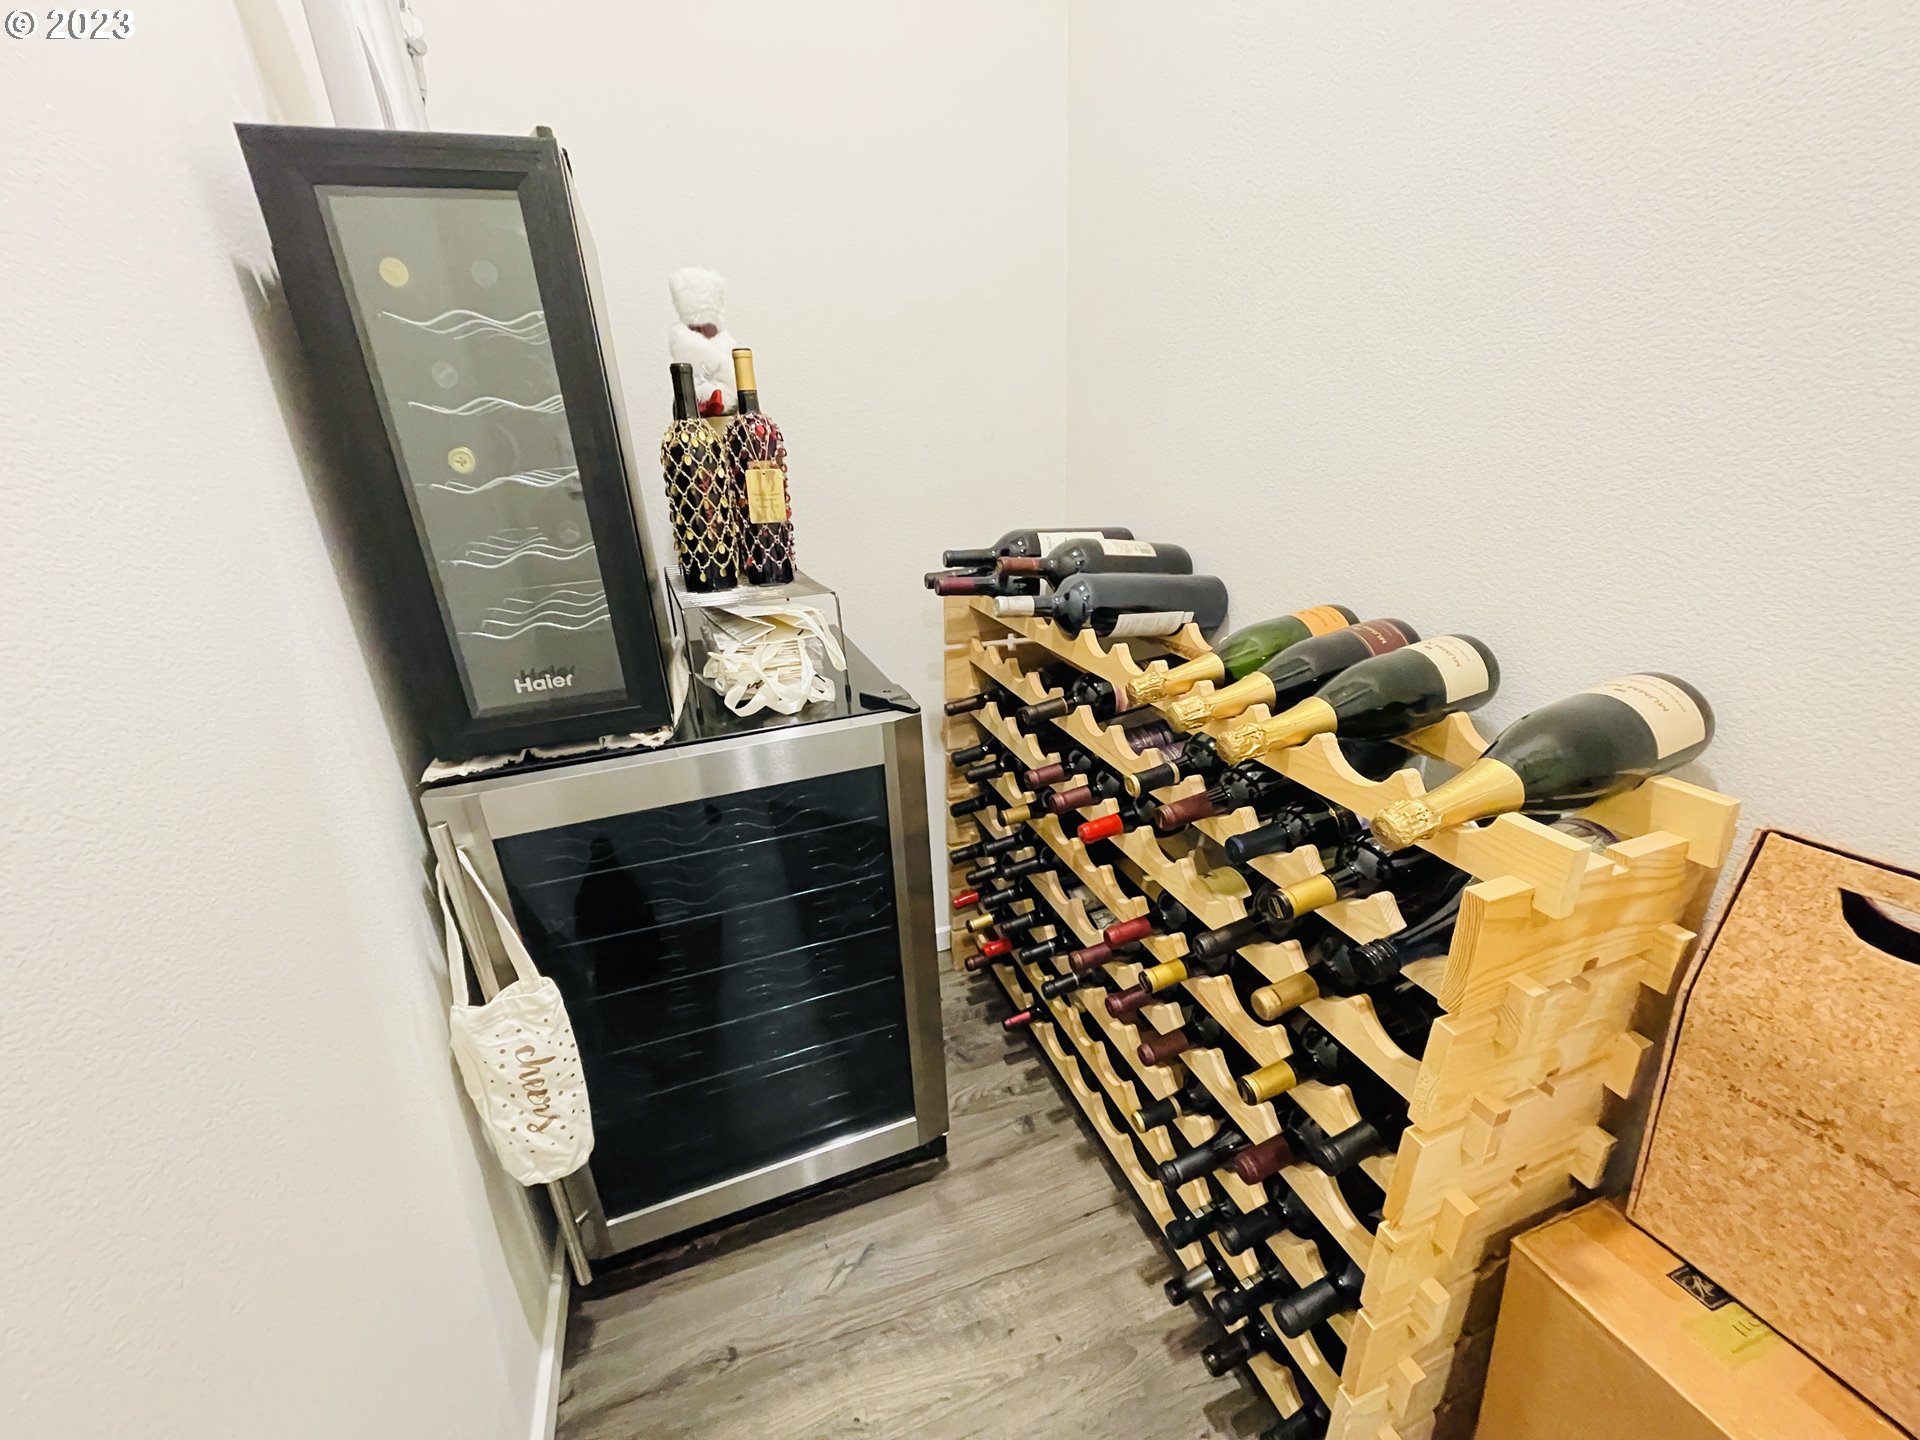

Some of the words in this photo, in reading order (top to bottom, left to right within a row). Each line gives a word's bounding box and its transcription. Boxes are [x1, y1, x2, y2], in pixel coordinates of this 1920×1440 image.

[514, 674, 574, 694] Haier
[1627, 685, 1669, 712] MUMM
[514, 1044, 561, 1134] cheers
